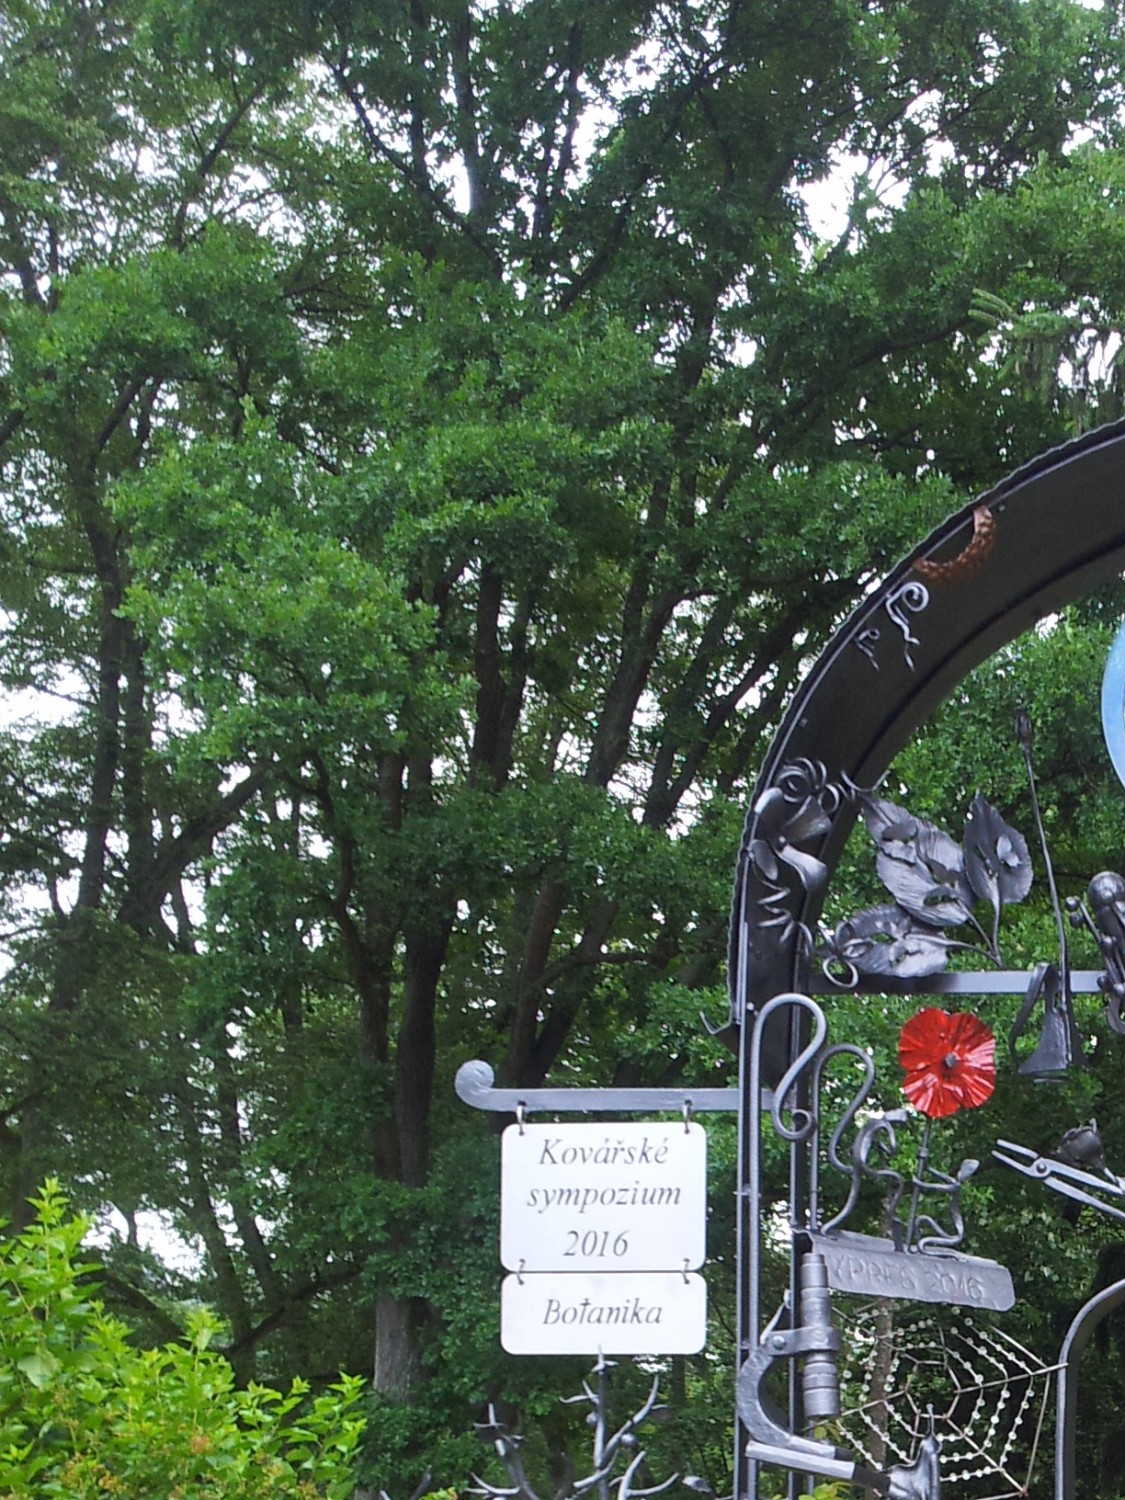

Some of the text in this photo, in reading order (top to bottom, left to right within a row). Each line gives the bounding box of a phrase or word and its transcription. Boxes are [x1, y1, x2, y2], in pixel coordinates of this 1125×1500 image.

[539, 1138, 669, 1165] Kovářské
[526, 1181, 681, 1214] sympozium
[563, 1230, 630, 1257] 2016
[925, 1266, 984, 1301] 2016
[542, 1298, 663, 1325] Botanika
